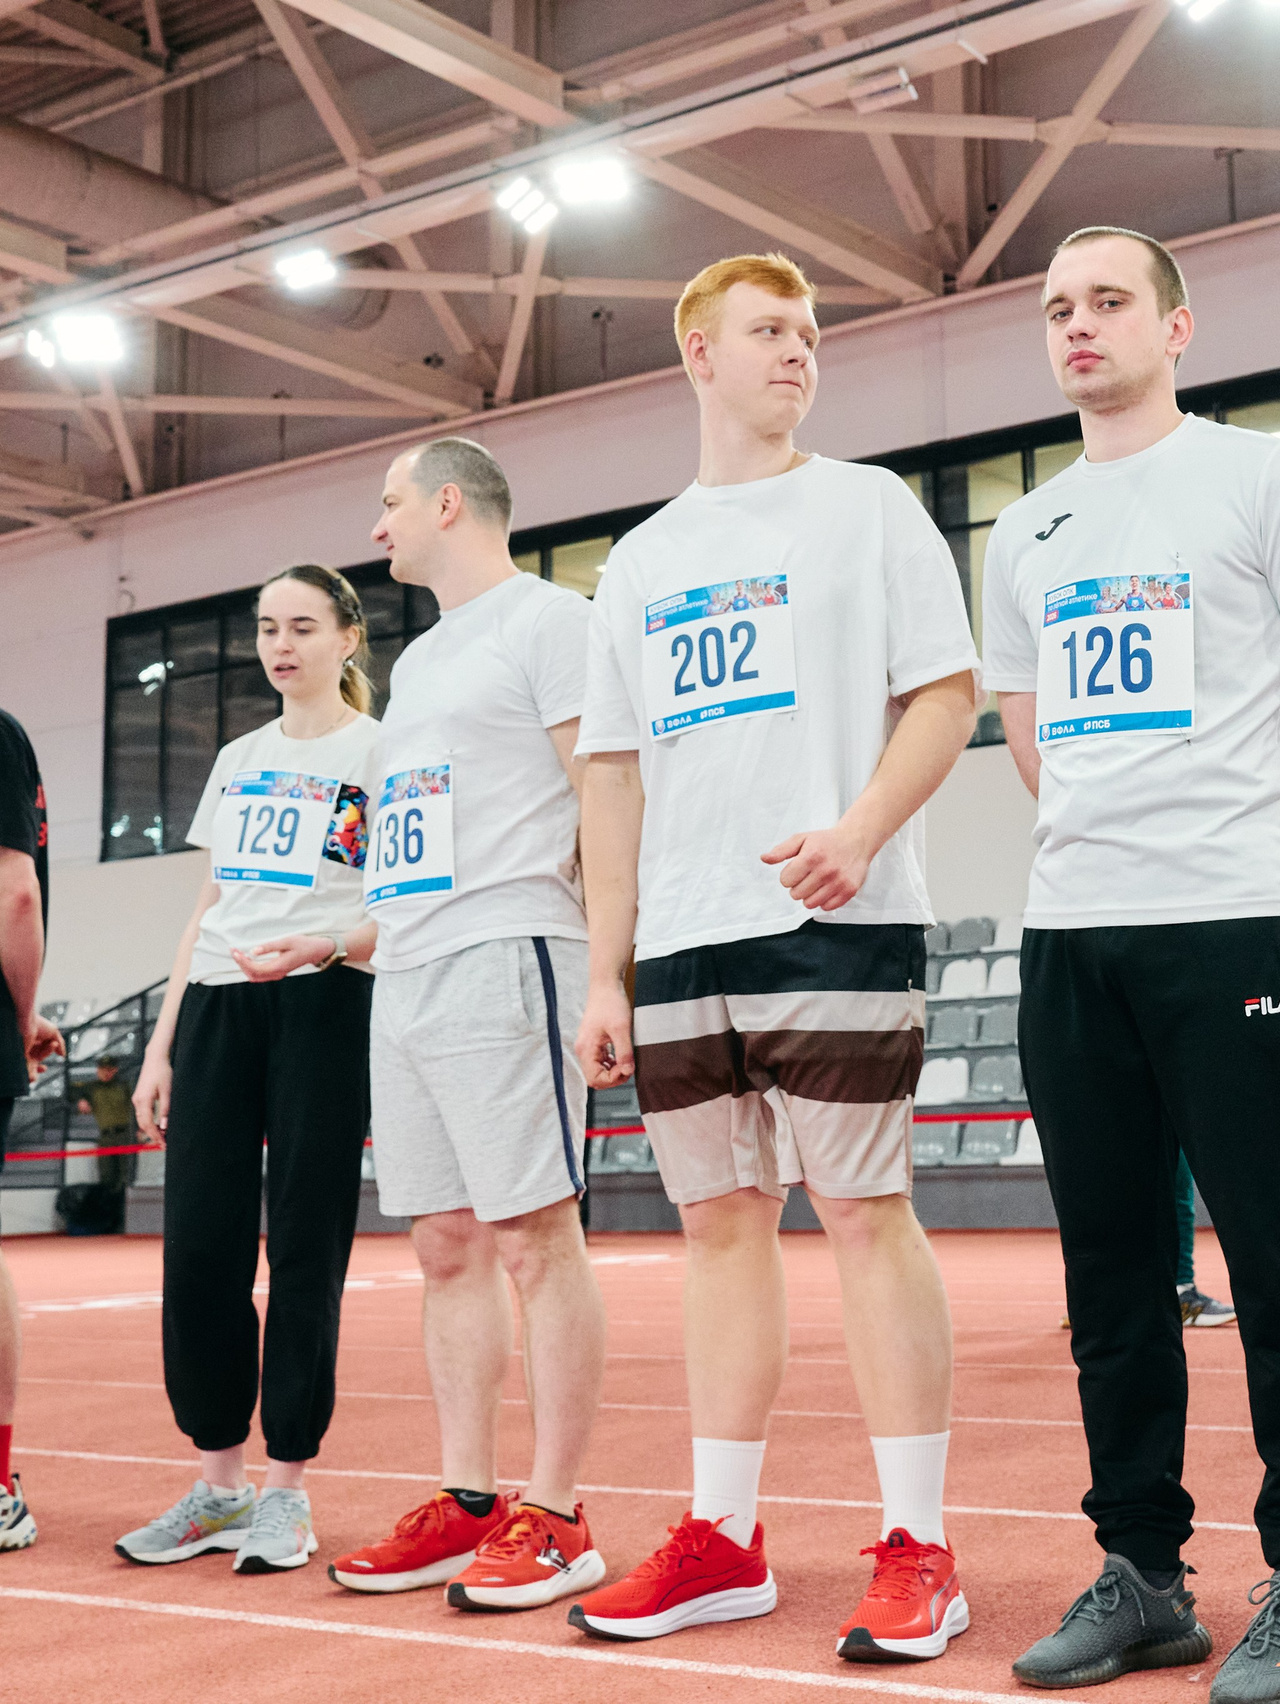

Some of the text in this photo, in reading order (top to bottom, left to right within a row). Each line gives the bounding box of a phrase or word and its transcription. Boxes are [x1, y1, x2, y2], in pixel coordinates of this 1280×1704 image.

[671, 620, 759, 697] 202
[1062, 622, 1153, 700] 126
[1052, 719, 1111, 736] ВФЛА ПСБ
[238, 804, 300, 857] 129
[376, 808, 424, 873] 136
